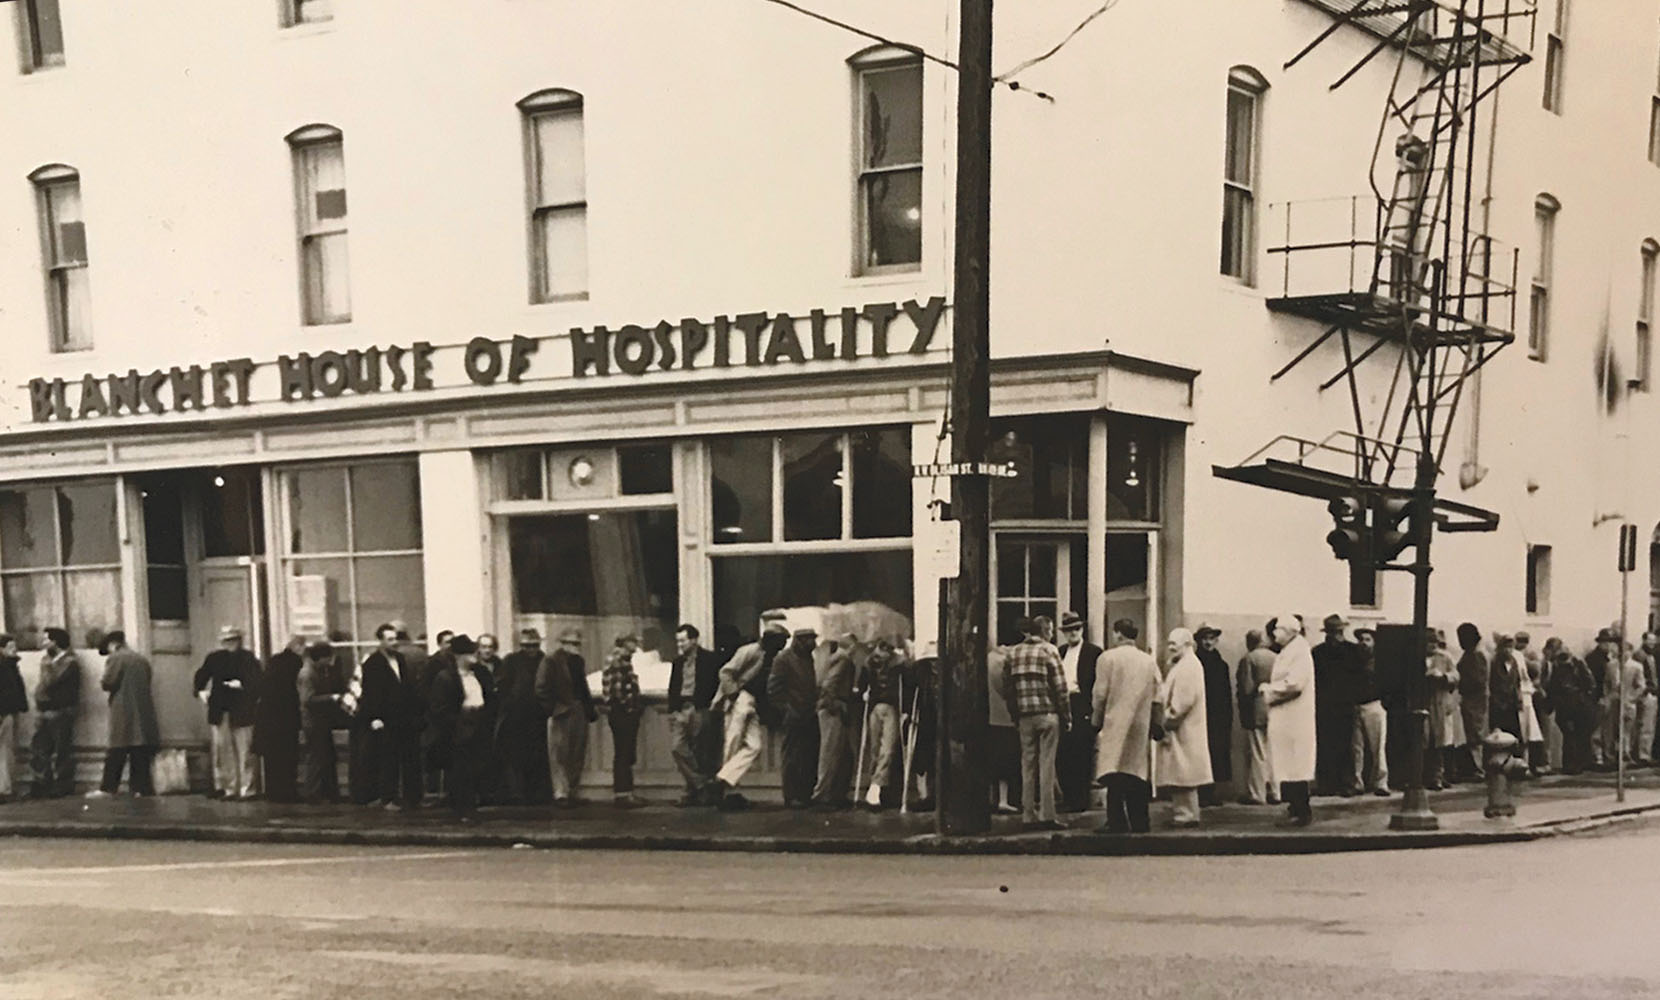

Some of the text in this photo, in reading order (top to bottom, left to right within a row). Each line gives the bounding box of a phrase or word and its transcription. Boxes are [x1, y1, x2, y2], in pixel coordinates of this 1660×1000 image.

[29, 297, 946, 422] BLANCHET HOUSE OF HOSPITALITY
